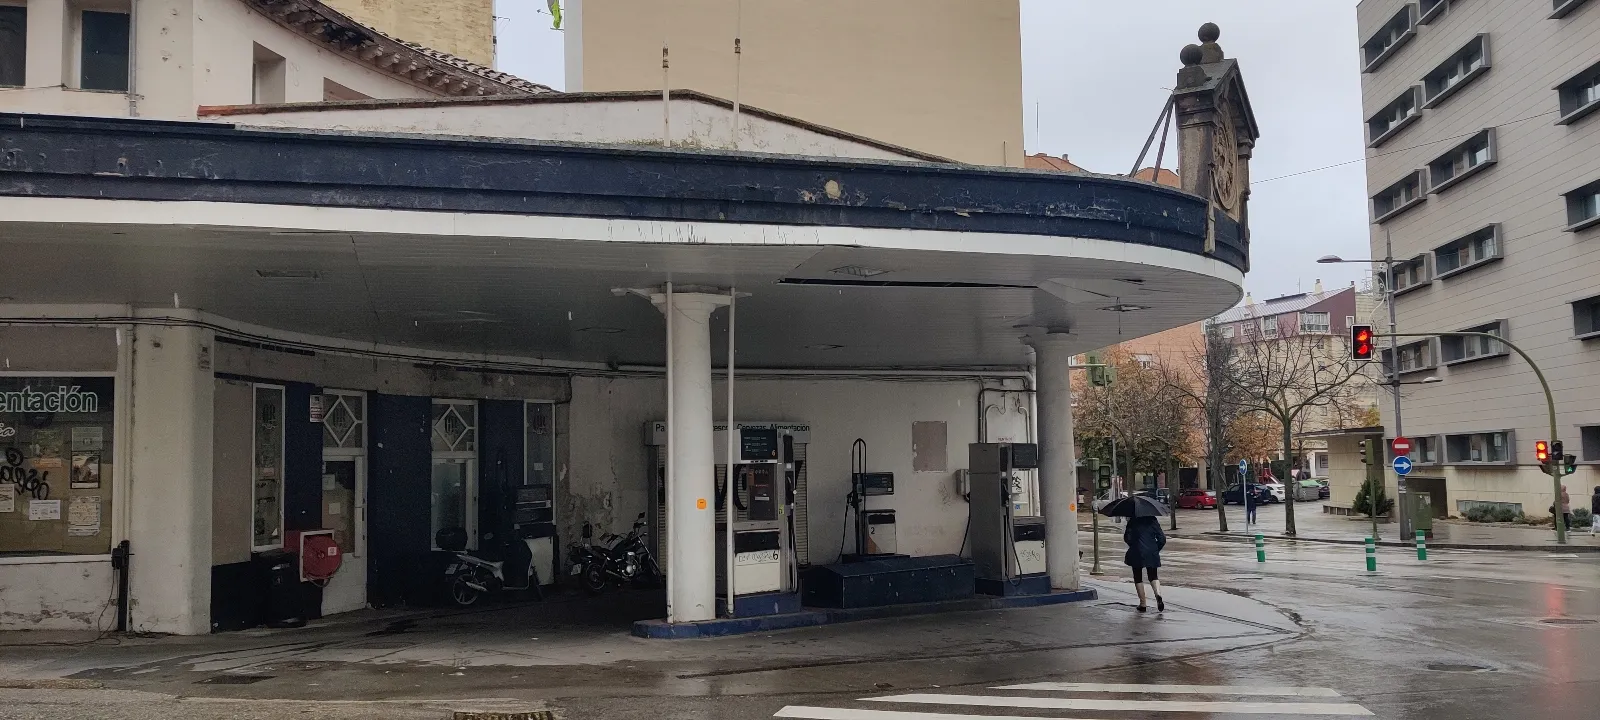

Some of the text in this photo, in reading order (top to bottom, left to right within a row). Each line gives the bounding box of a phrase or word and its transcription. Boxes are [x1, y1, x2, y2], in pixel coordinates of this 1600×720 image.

[770, 423, 810, 431] Alimentación
[870, 526, 875, 534] 2
[1040, 540, 1045, 548] 3
[772, 550, 779, 560] 6
